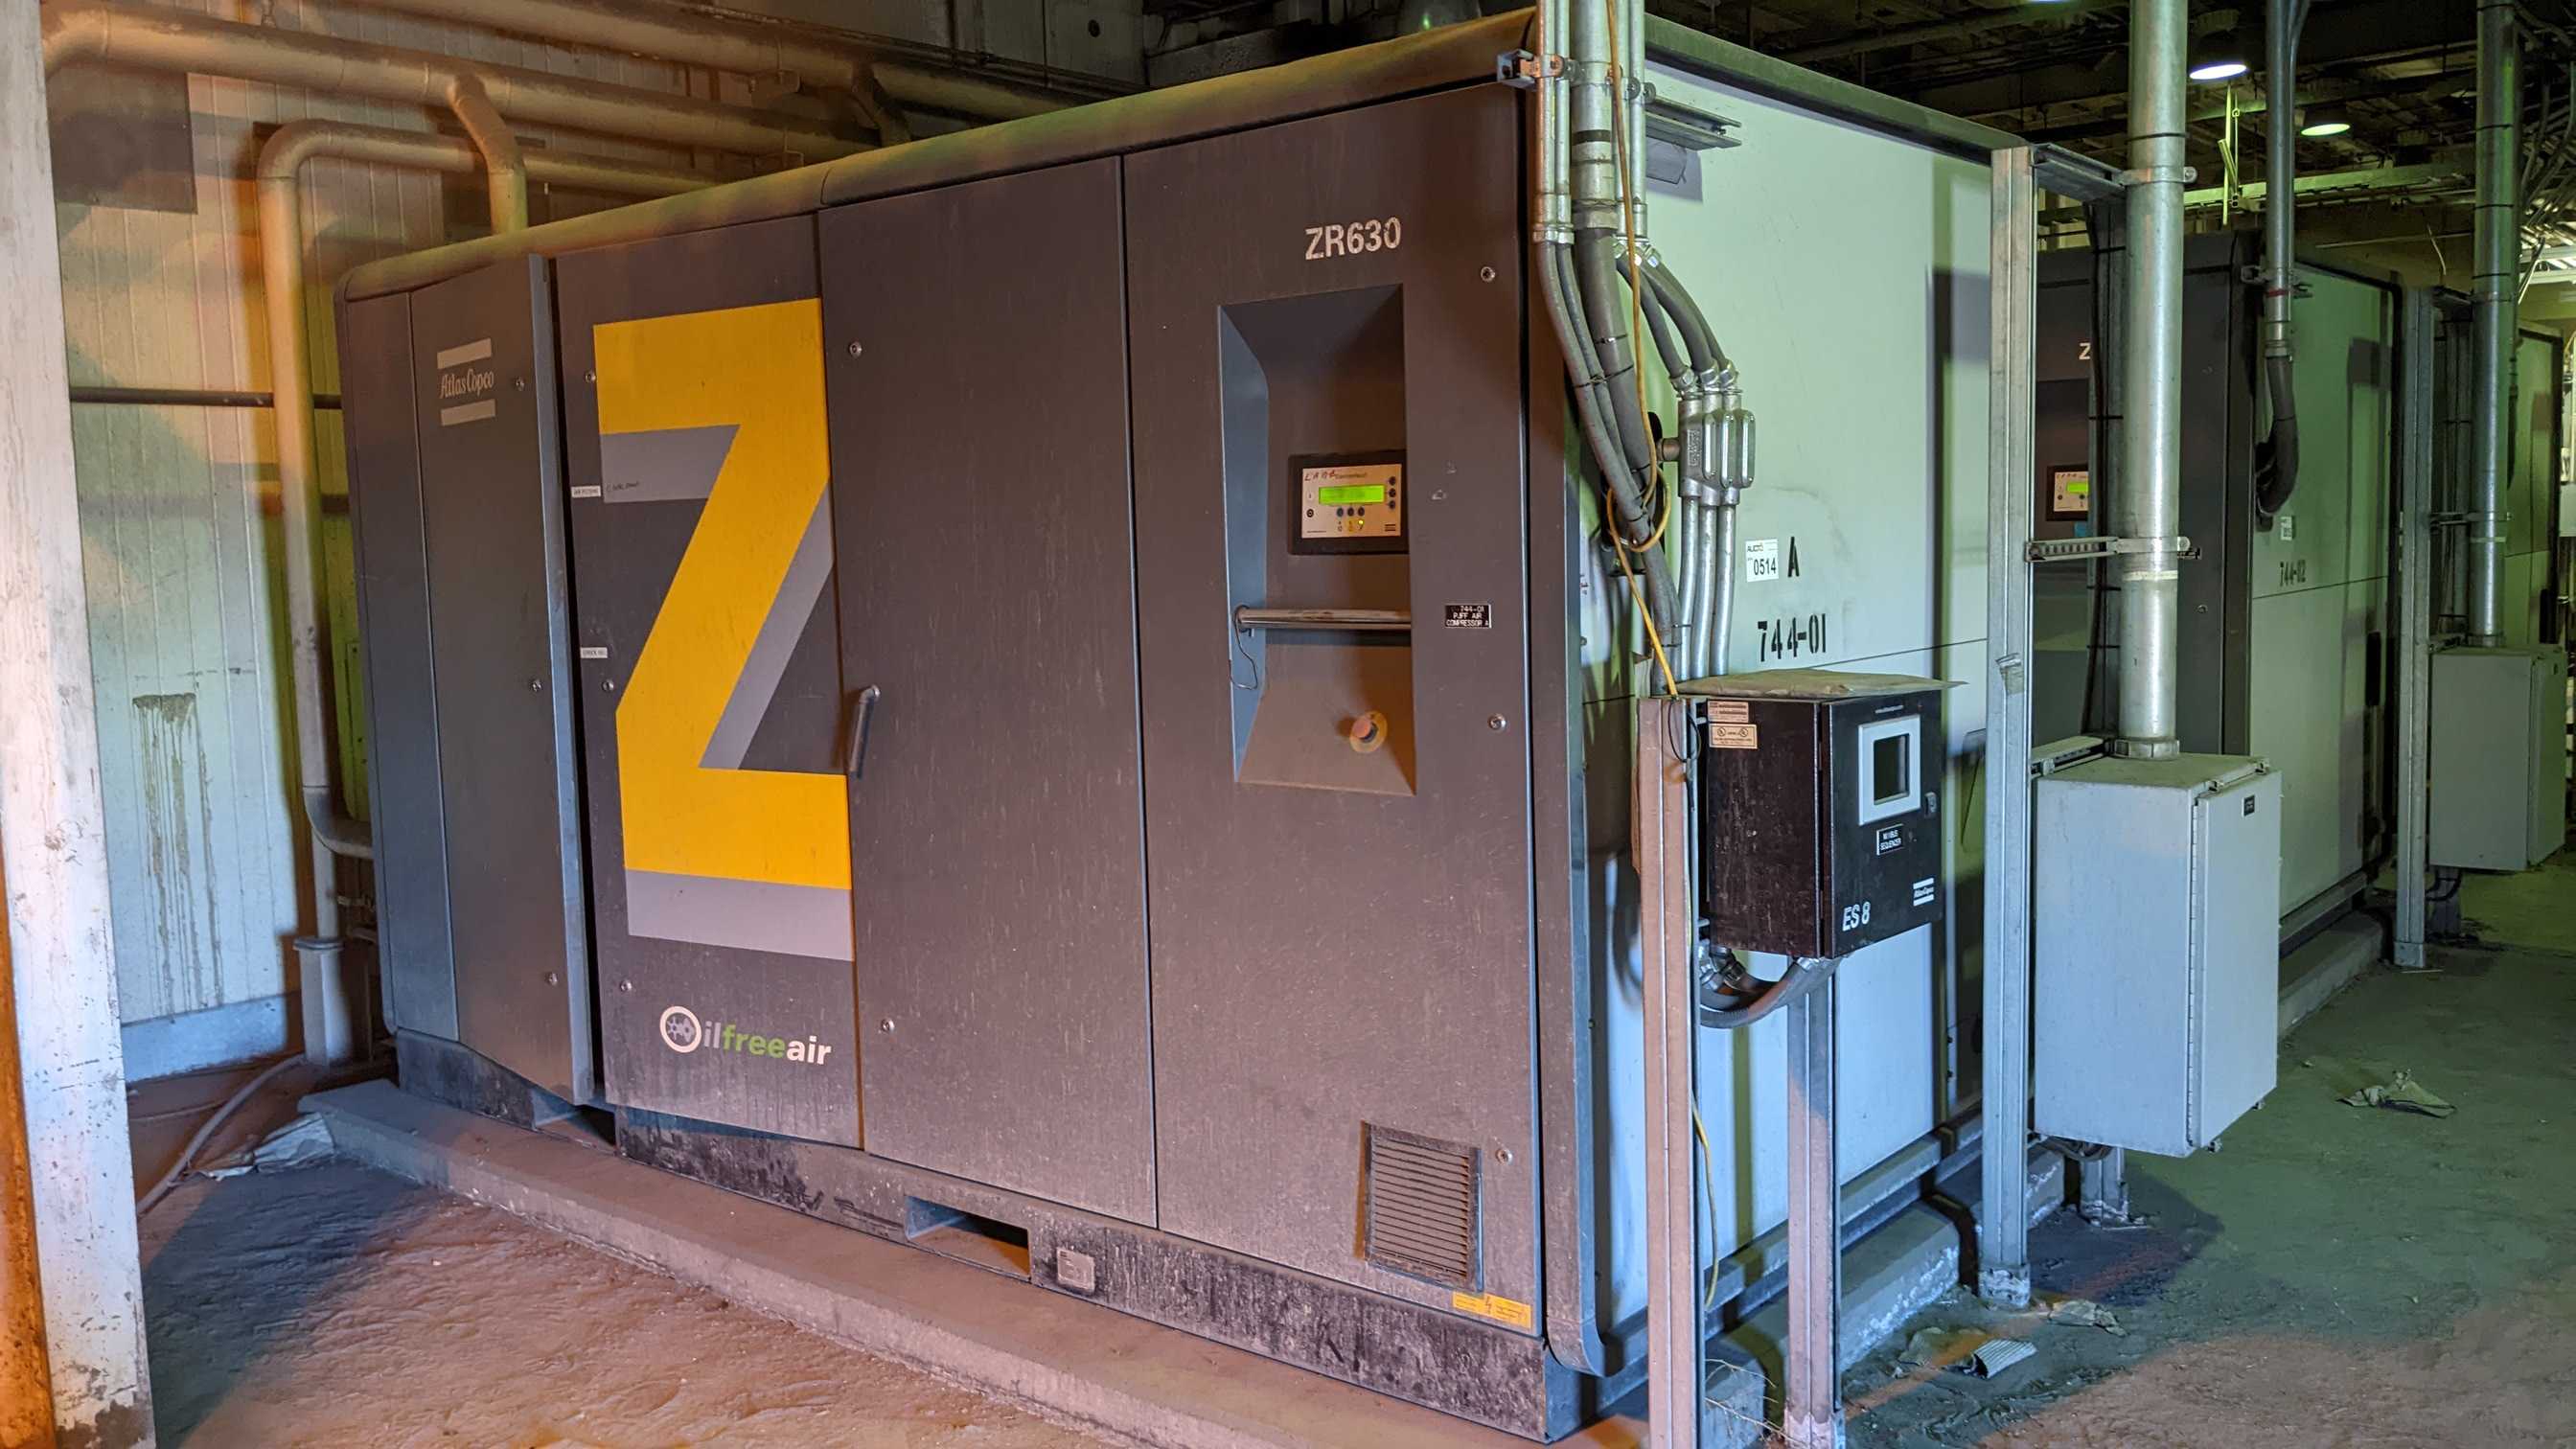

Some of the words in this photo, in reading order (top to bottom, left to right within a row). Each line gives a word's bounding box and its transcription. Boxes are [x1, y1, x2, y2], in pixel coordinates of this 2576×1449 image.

[1305, 217, 1401, 260] ZR630
[1754, 558, 1777, 575] 0514
[1787, 537, 1800, 577] A
[1758, 613, 1826, 662] 744-01
[1842, 906, 1860, 932] ES
[1862, 902, 1871, 925] 8
